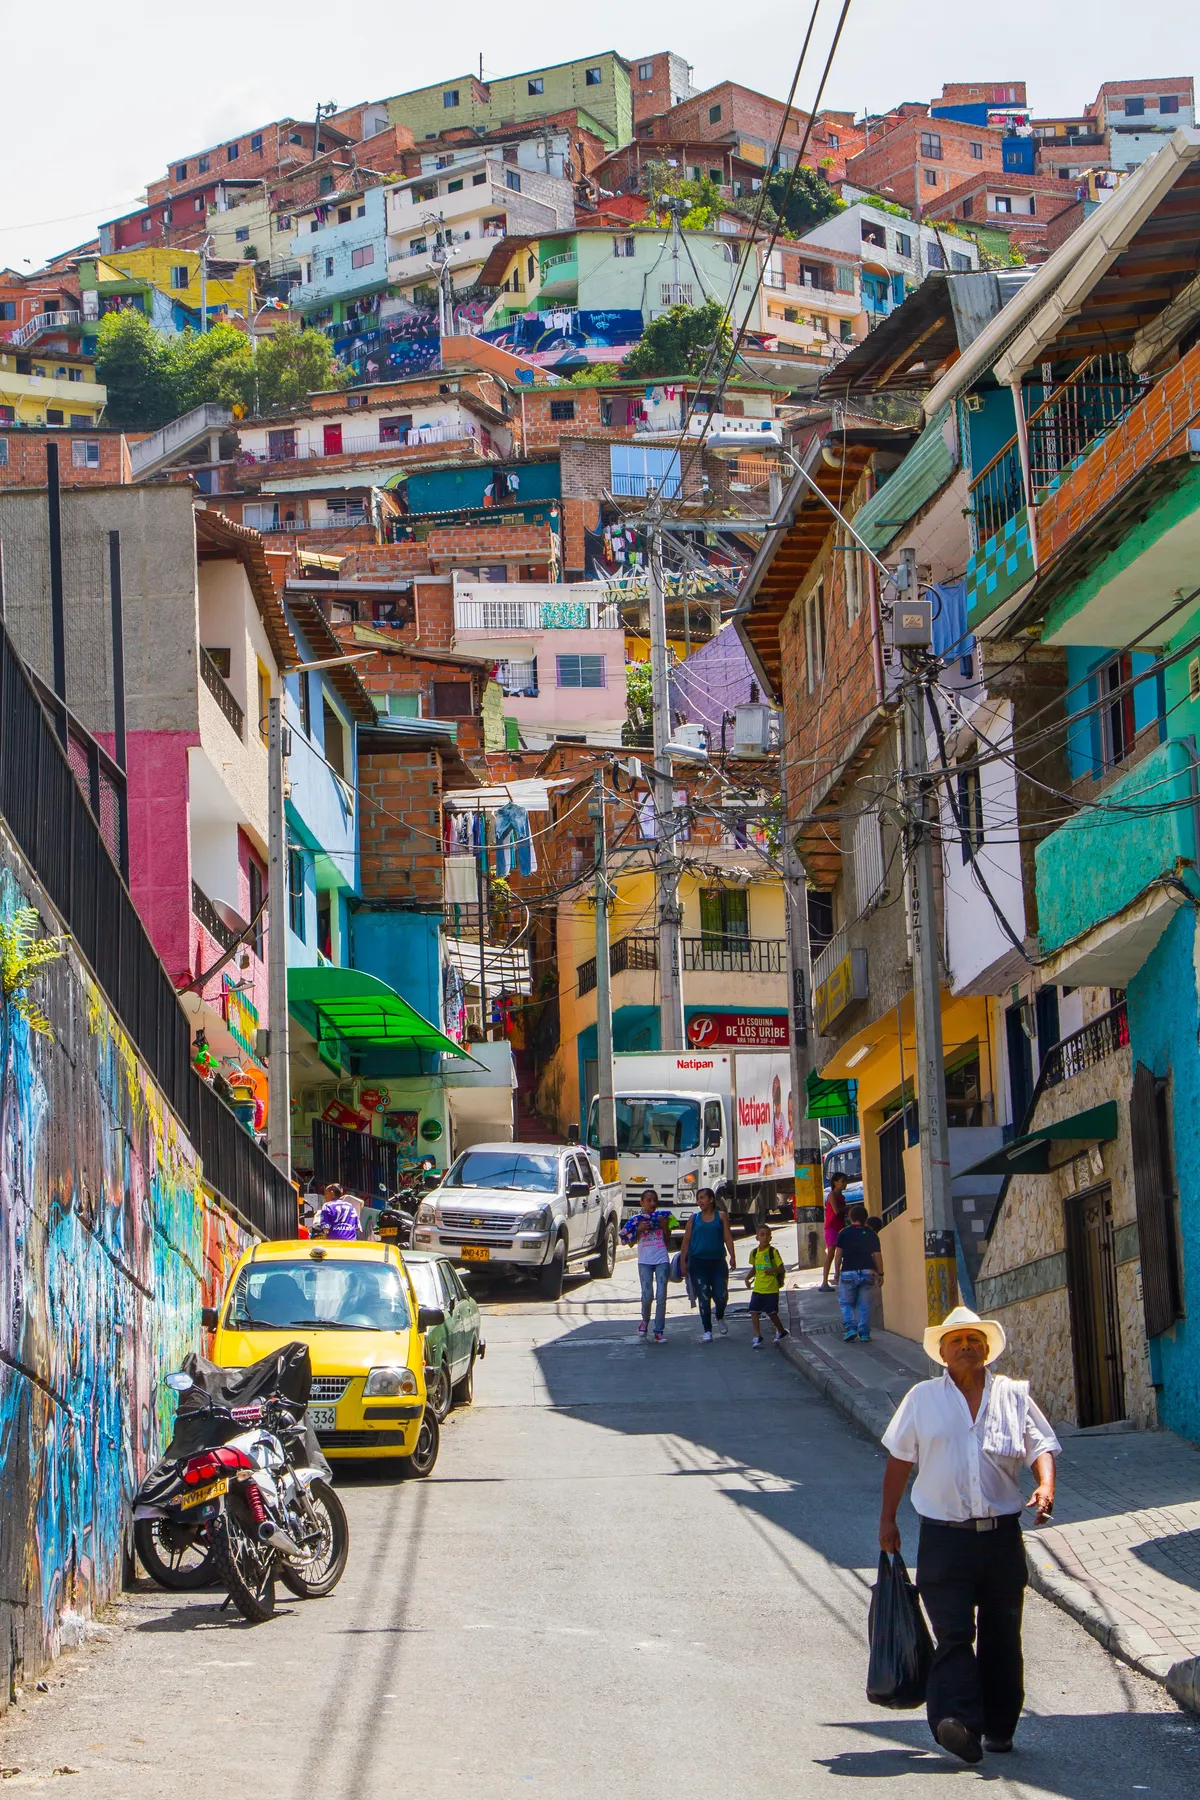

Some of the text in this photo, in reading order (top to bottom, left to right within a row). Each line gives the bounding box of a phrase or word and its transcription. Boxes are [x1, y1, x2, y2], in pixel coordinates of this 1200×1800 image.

[737, 1018, 774, 1026] LA ESQUINA
[726, 1026, 785, 1038] DE LOS URIBE
[676, 1058, 714, 1071] Natipan
[738, 1095, 771, 1133] Natipan
[334, 1205, 351, 1223] 17
[313, 1411, 335, 1424] 336
